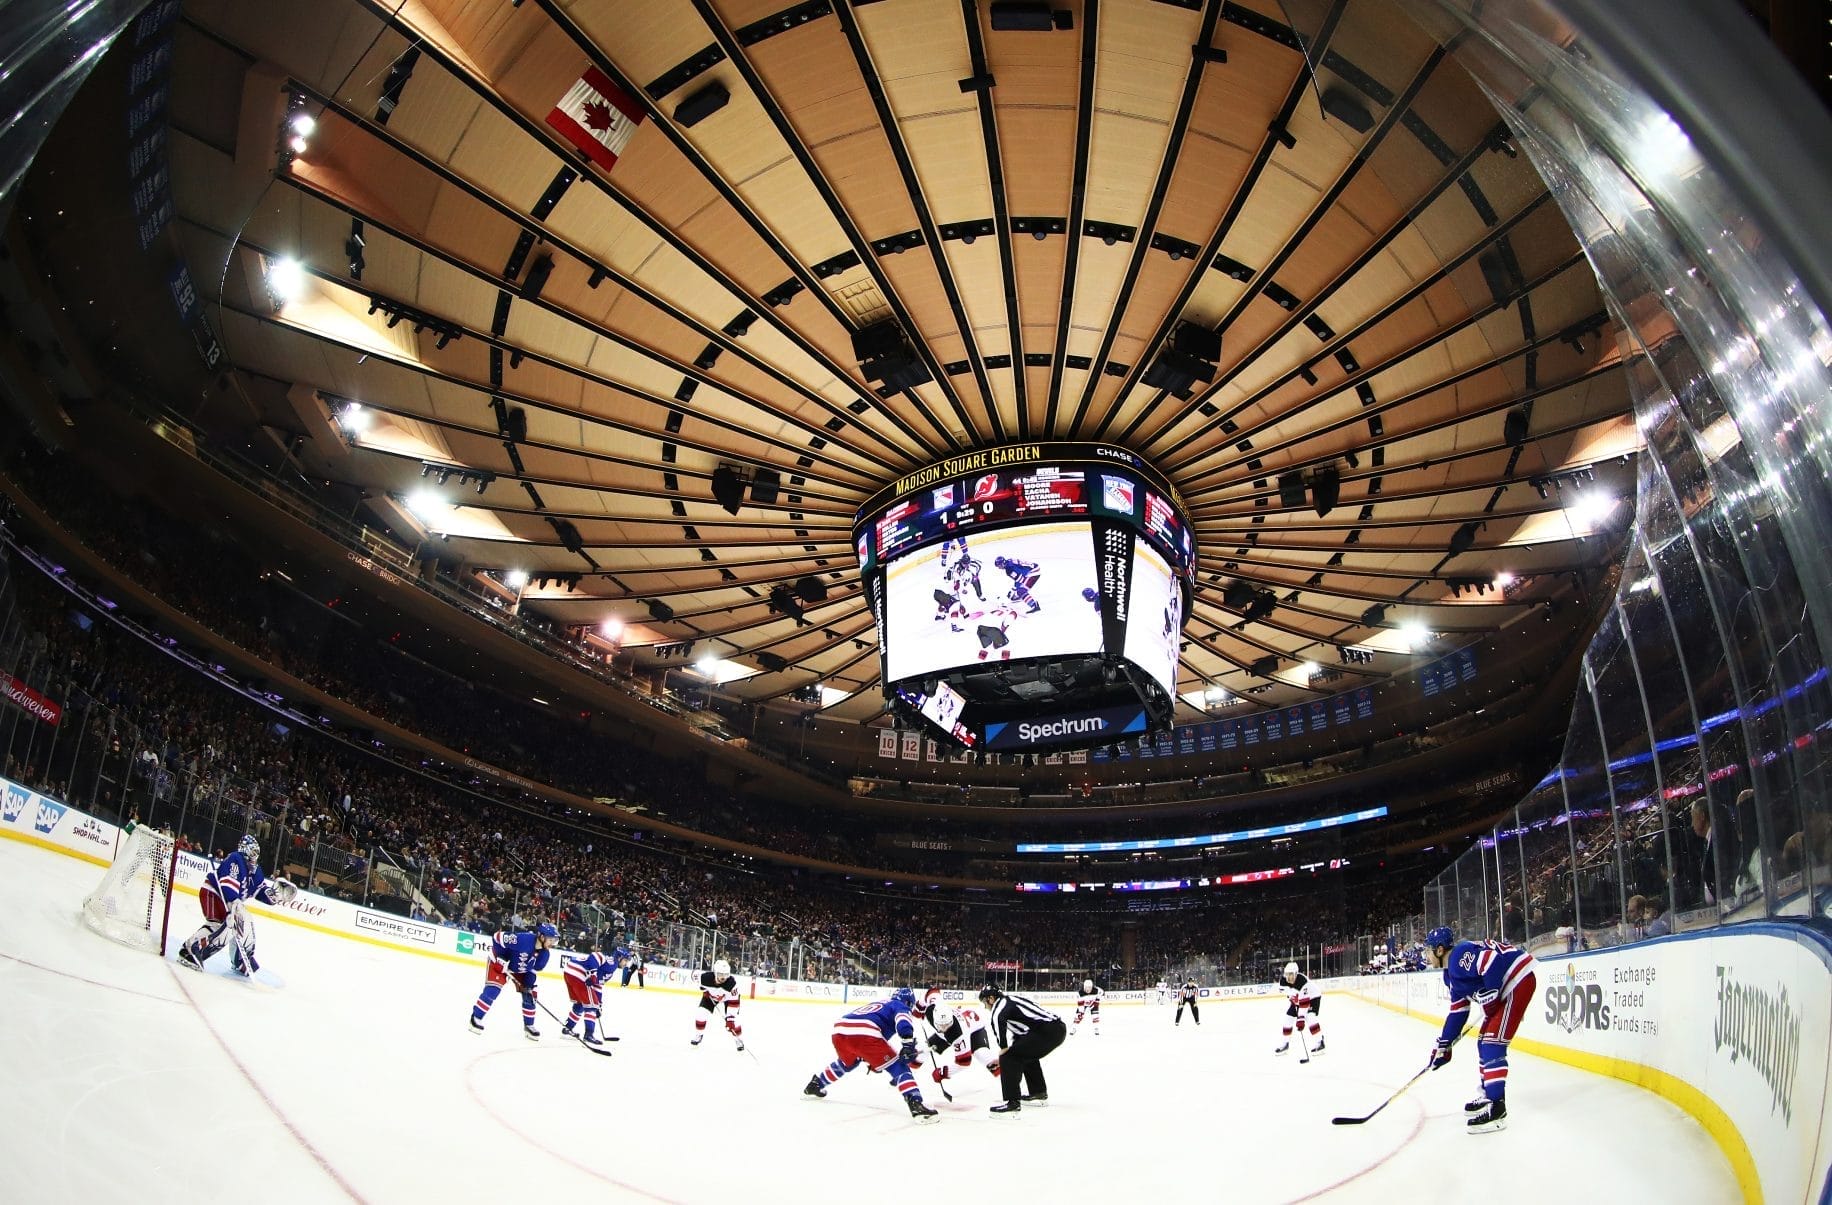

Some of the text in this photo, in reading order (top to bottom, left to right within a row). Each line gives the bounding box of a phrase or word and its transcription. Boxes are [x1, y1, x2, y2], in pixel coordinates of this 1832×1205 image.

[1097, 448, 1133, 462] CHASE
[896, 446, 1040, 496] MADISON SQUARE GARDEN
[940, 501, 994, 524] 1 0
[1104, 555, 1115, 593] Health
[1117, 557, 1126, 621] Northwell
[1018, 716, 1102, 743] Spectrum
[883, 738, 894, 749] 10
[905, 741, 917, 752] 12
[6, 792, 24, 816] SAP
[37, 804, 59, 828] SAP
[911, 840, 928, 849] BLUE
[360, 916, 432, 938] EMPIRE CITY
[1459, 952, 1475, 971] 22
[1576, 971, 1597, 981] SECTOR
[1614, 965, 1656, 985] Exchange
[943, 992, 963, 1000] GEICO
[1224, 988, 1254, 996] DELTA
[1613, 991, 1644, 1008] Traded
[1613, 1015, 1639, 1033] Funds
